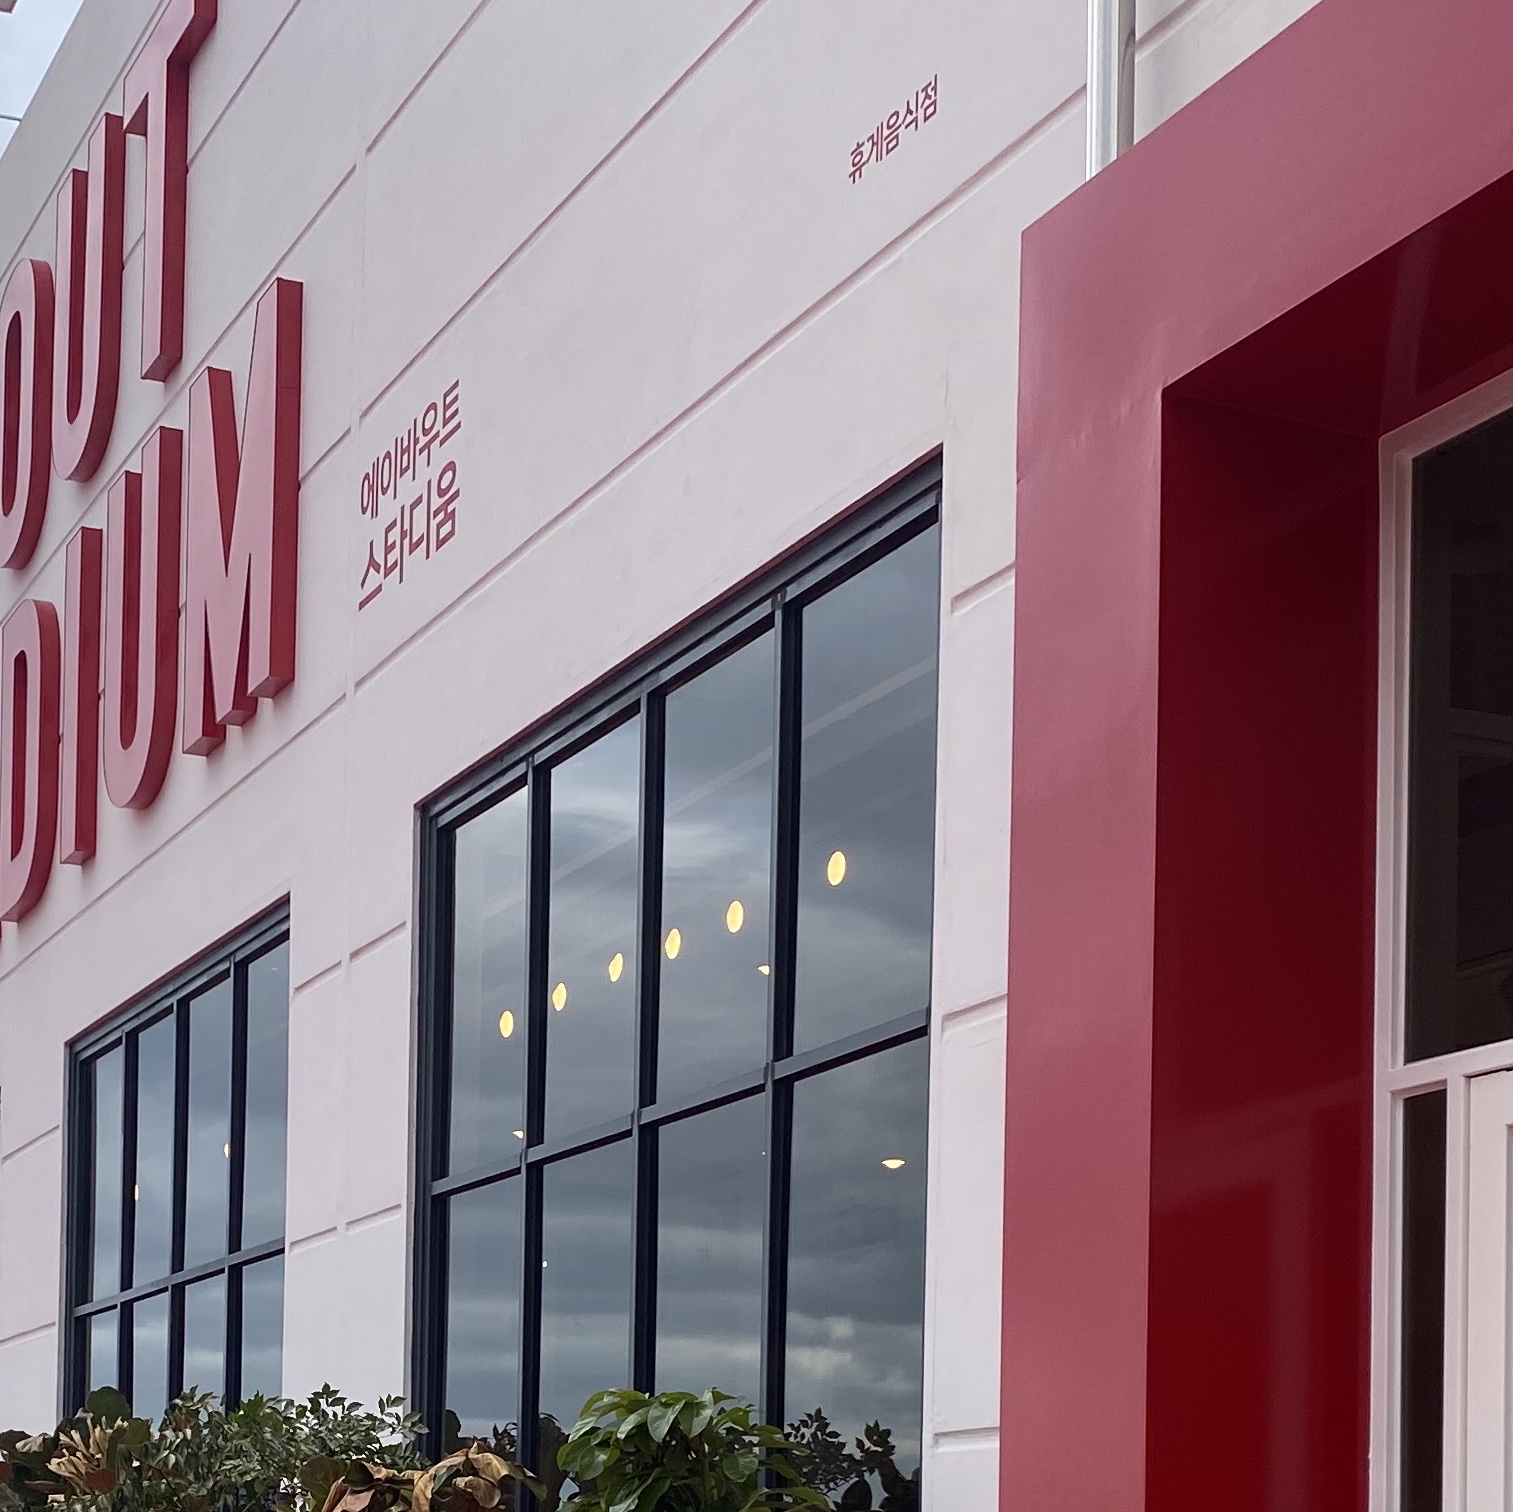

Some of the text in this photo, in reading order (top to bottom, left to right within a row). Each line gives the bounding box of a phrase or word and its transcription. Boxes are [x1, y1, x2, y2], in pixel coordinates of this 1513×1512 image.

[849, 73, 938, 184] 휴게음식점
[360, 378, 462, 520] 에이바우트
[358, 460, 461, 612] 스타디움
